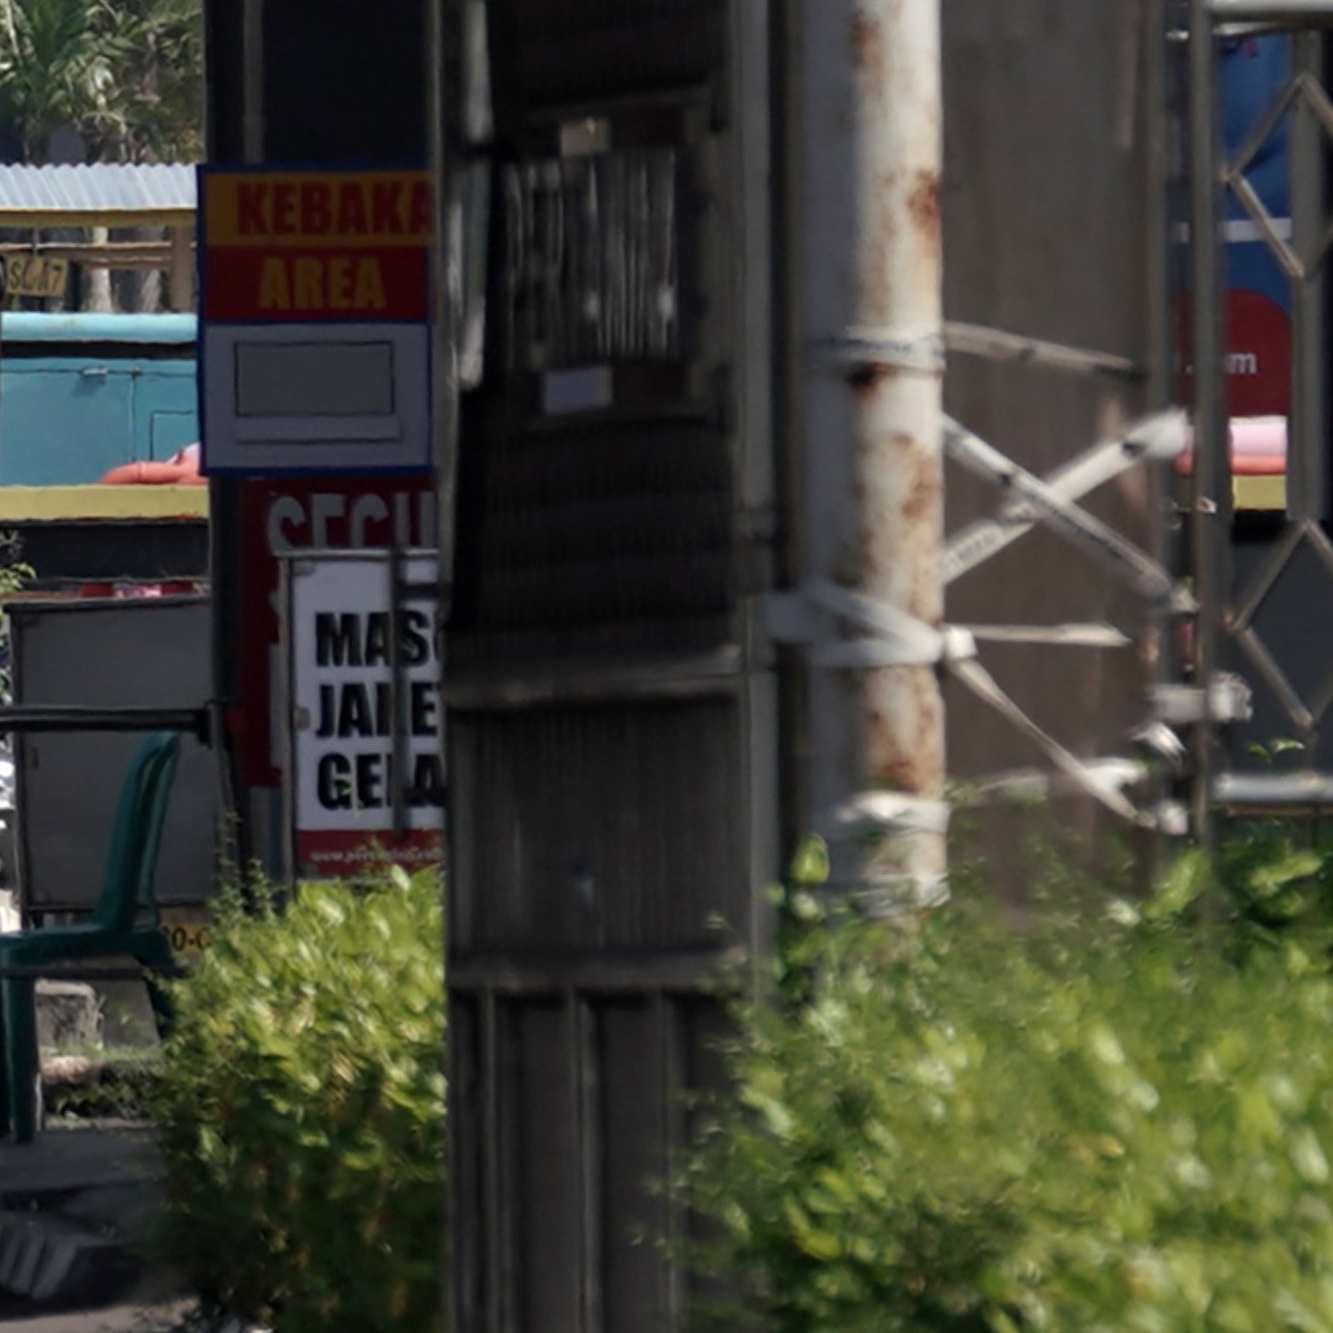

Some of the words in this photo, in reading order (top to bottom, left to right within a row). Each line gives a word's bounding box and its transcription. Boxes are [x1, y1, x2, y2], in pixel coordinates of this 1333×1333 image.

[237, 181, 434, 235] KEBAKA
[258, 257, 386, 310] AREA
[315, 609, 439, 666] MAS
[315, 682, 440, 739] JAE
[315, 752, 444, 812] GEA
